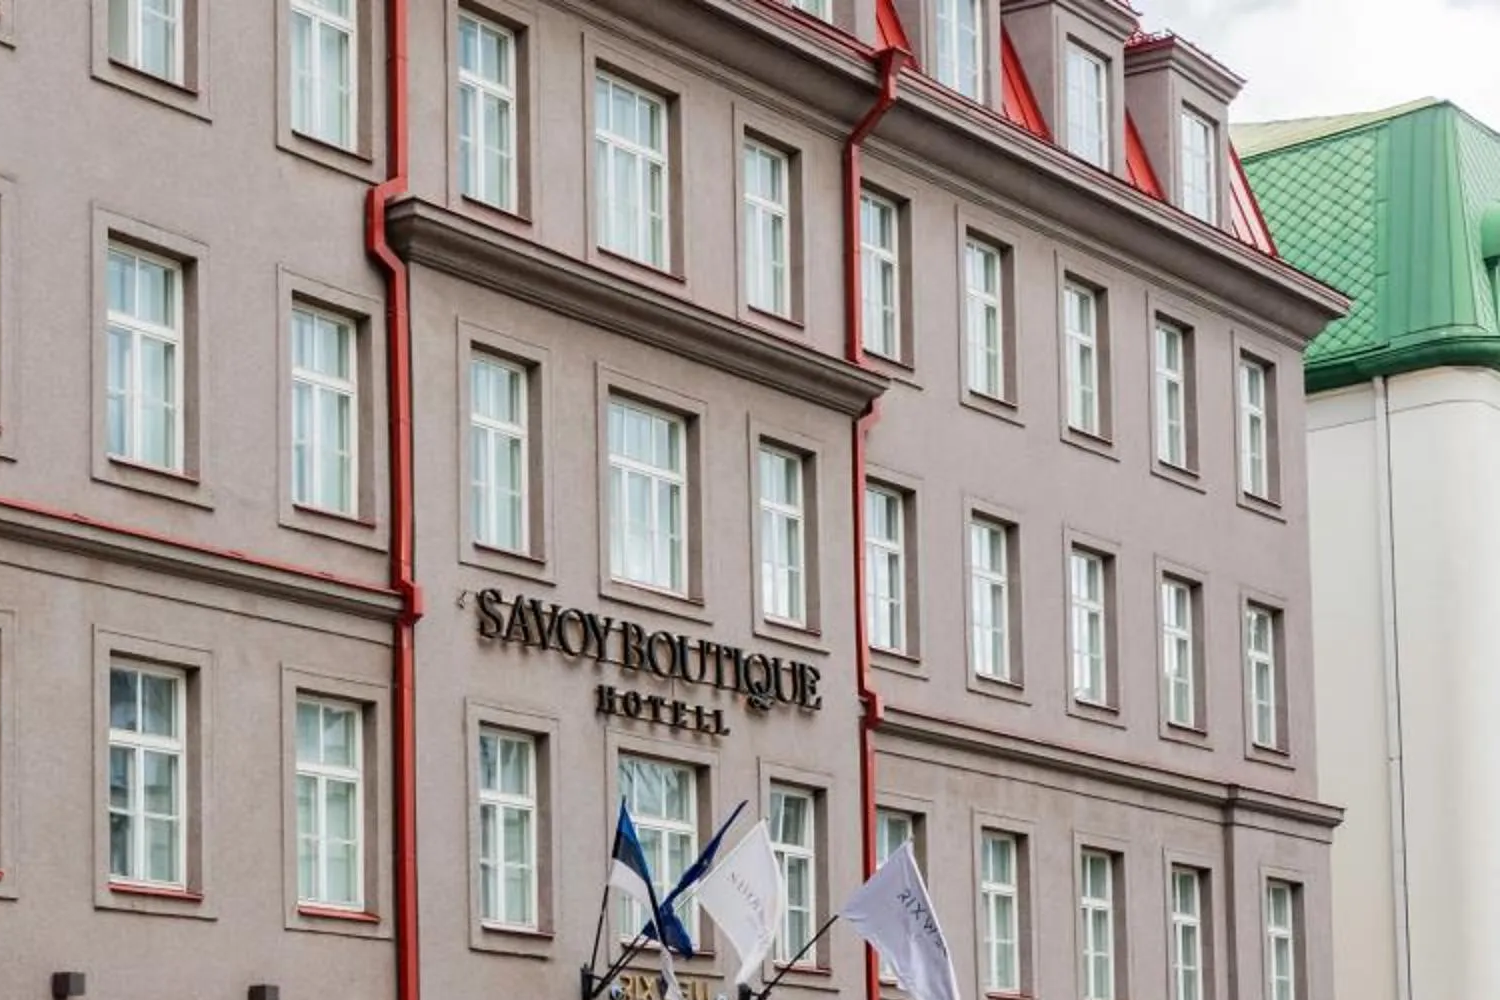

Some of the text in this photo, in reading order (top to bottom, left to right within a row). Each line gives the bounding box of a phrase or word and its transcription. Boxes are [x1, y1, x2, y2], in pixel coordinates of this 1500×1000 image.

[475, 587, 824, 712] SAVOY BOUTIQUE
[596, 683, 731, 736] HOTELL
